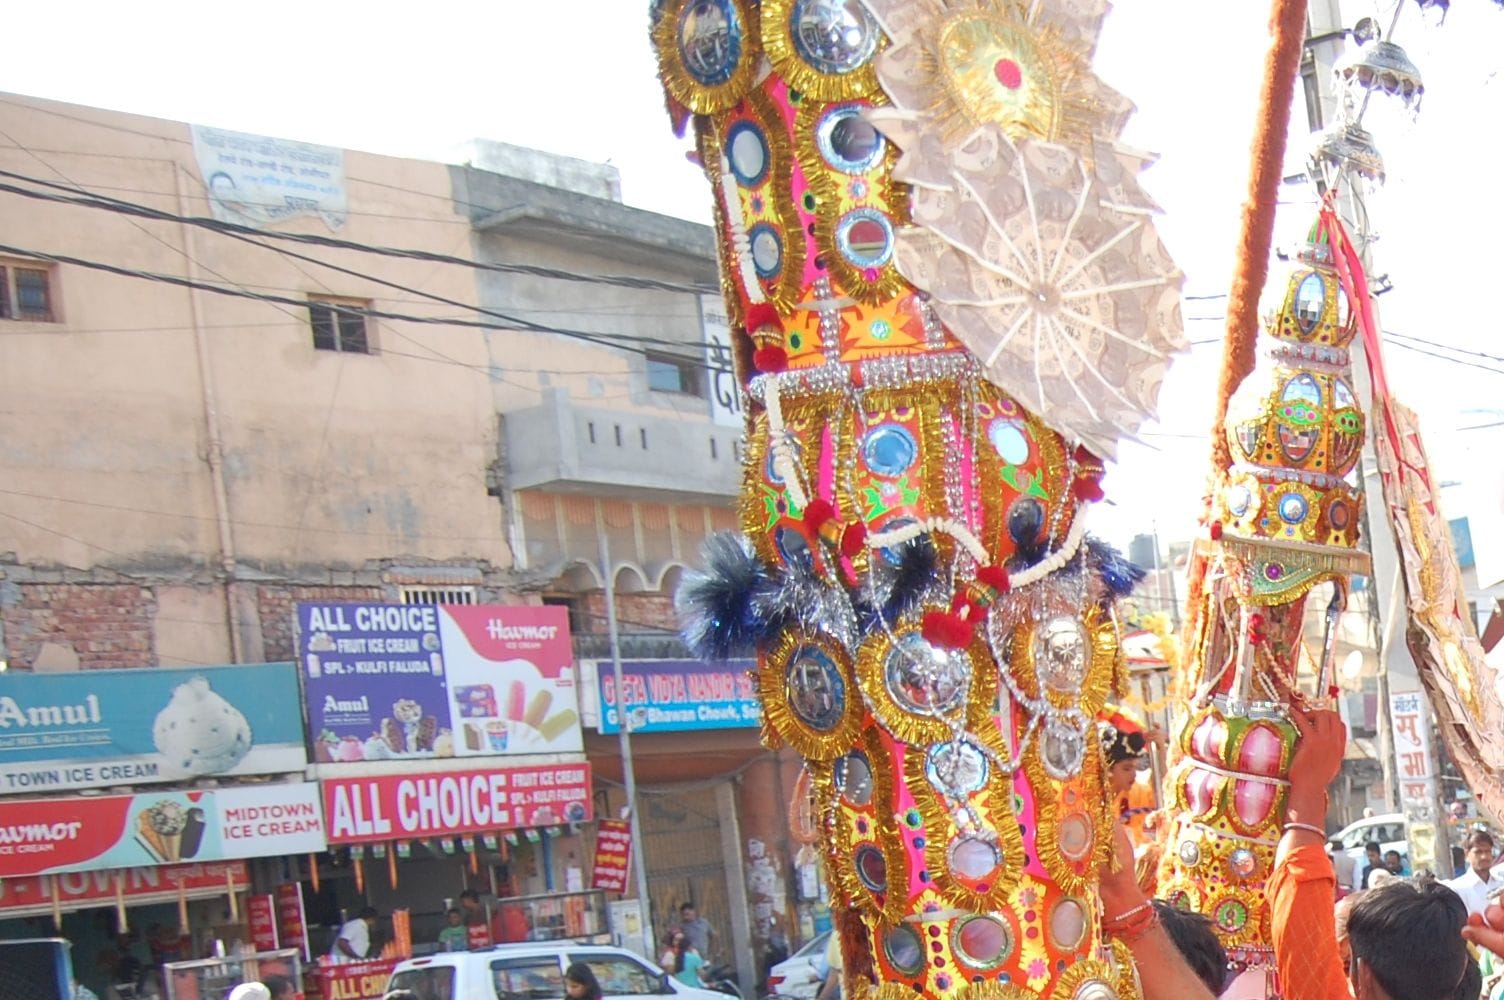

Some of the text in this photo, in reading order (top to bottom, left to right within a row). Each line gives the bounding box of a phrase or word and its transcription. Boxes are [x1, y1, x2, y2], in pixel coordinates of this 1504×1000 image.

[309, 606, 437, 632] ALL CHOICE
[486, 618, 558, 640] Havmor
[337, 638, 420, 654] FRUIT ICE CREAM
[388, 660, 431, 673] FALUDA
[603, 673, 648, 706] GETA
[0, 694, 102, 728] Amul
[322, 695, 370, 713] Amul
[6, 763, 159, 788] TOWN ICE CREAM
[225, 803, 315, 822] MIDTOWN
[333, 774, 509, 838] ALL CHOICE
[224, 819, 321, 840] ICE CREAM
[330, 977, 360, 1000] ALL
